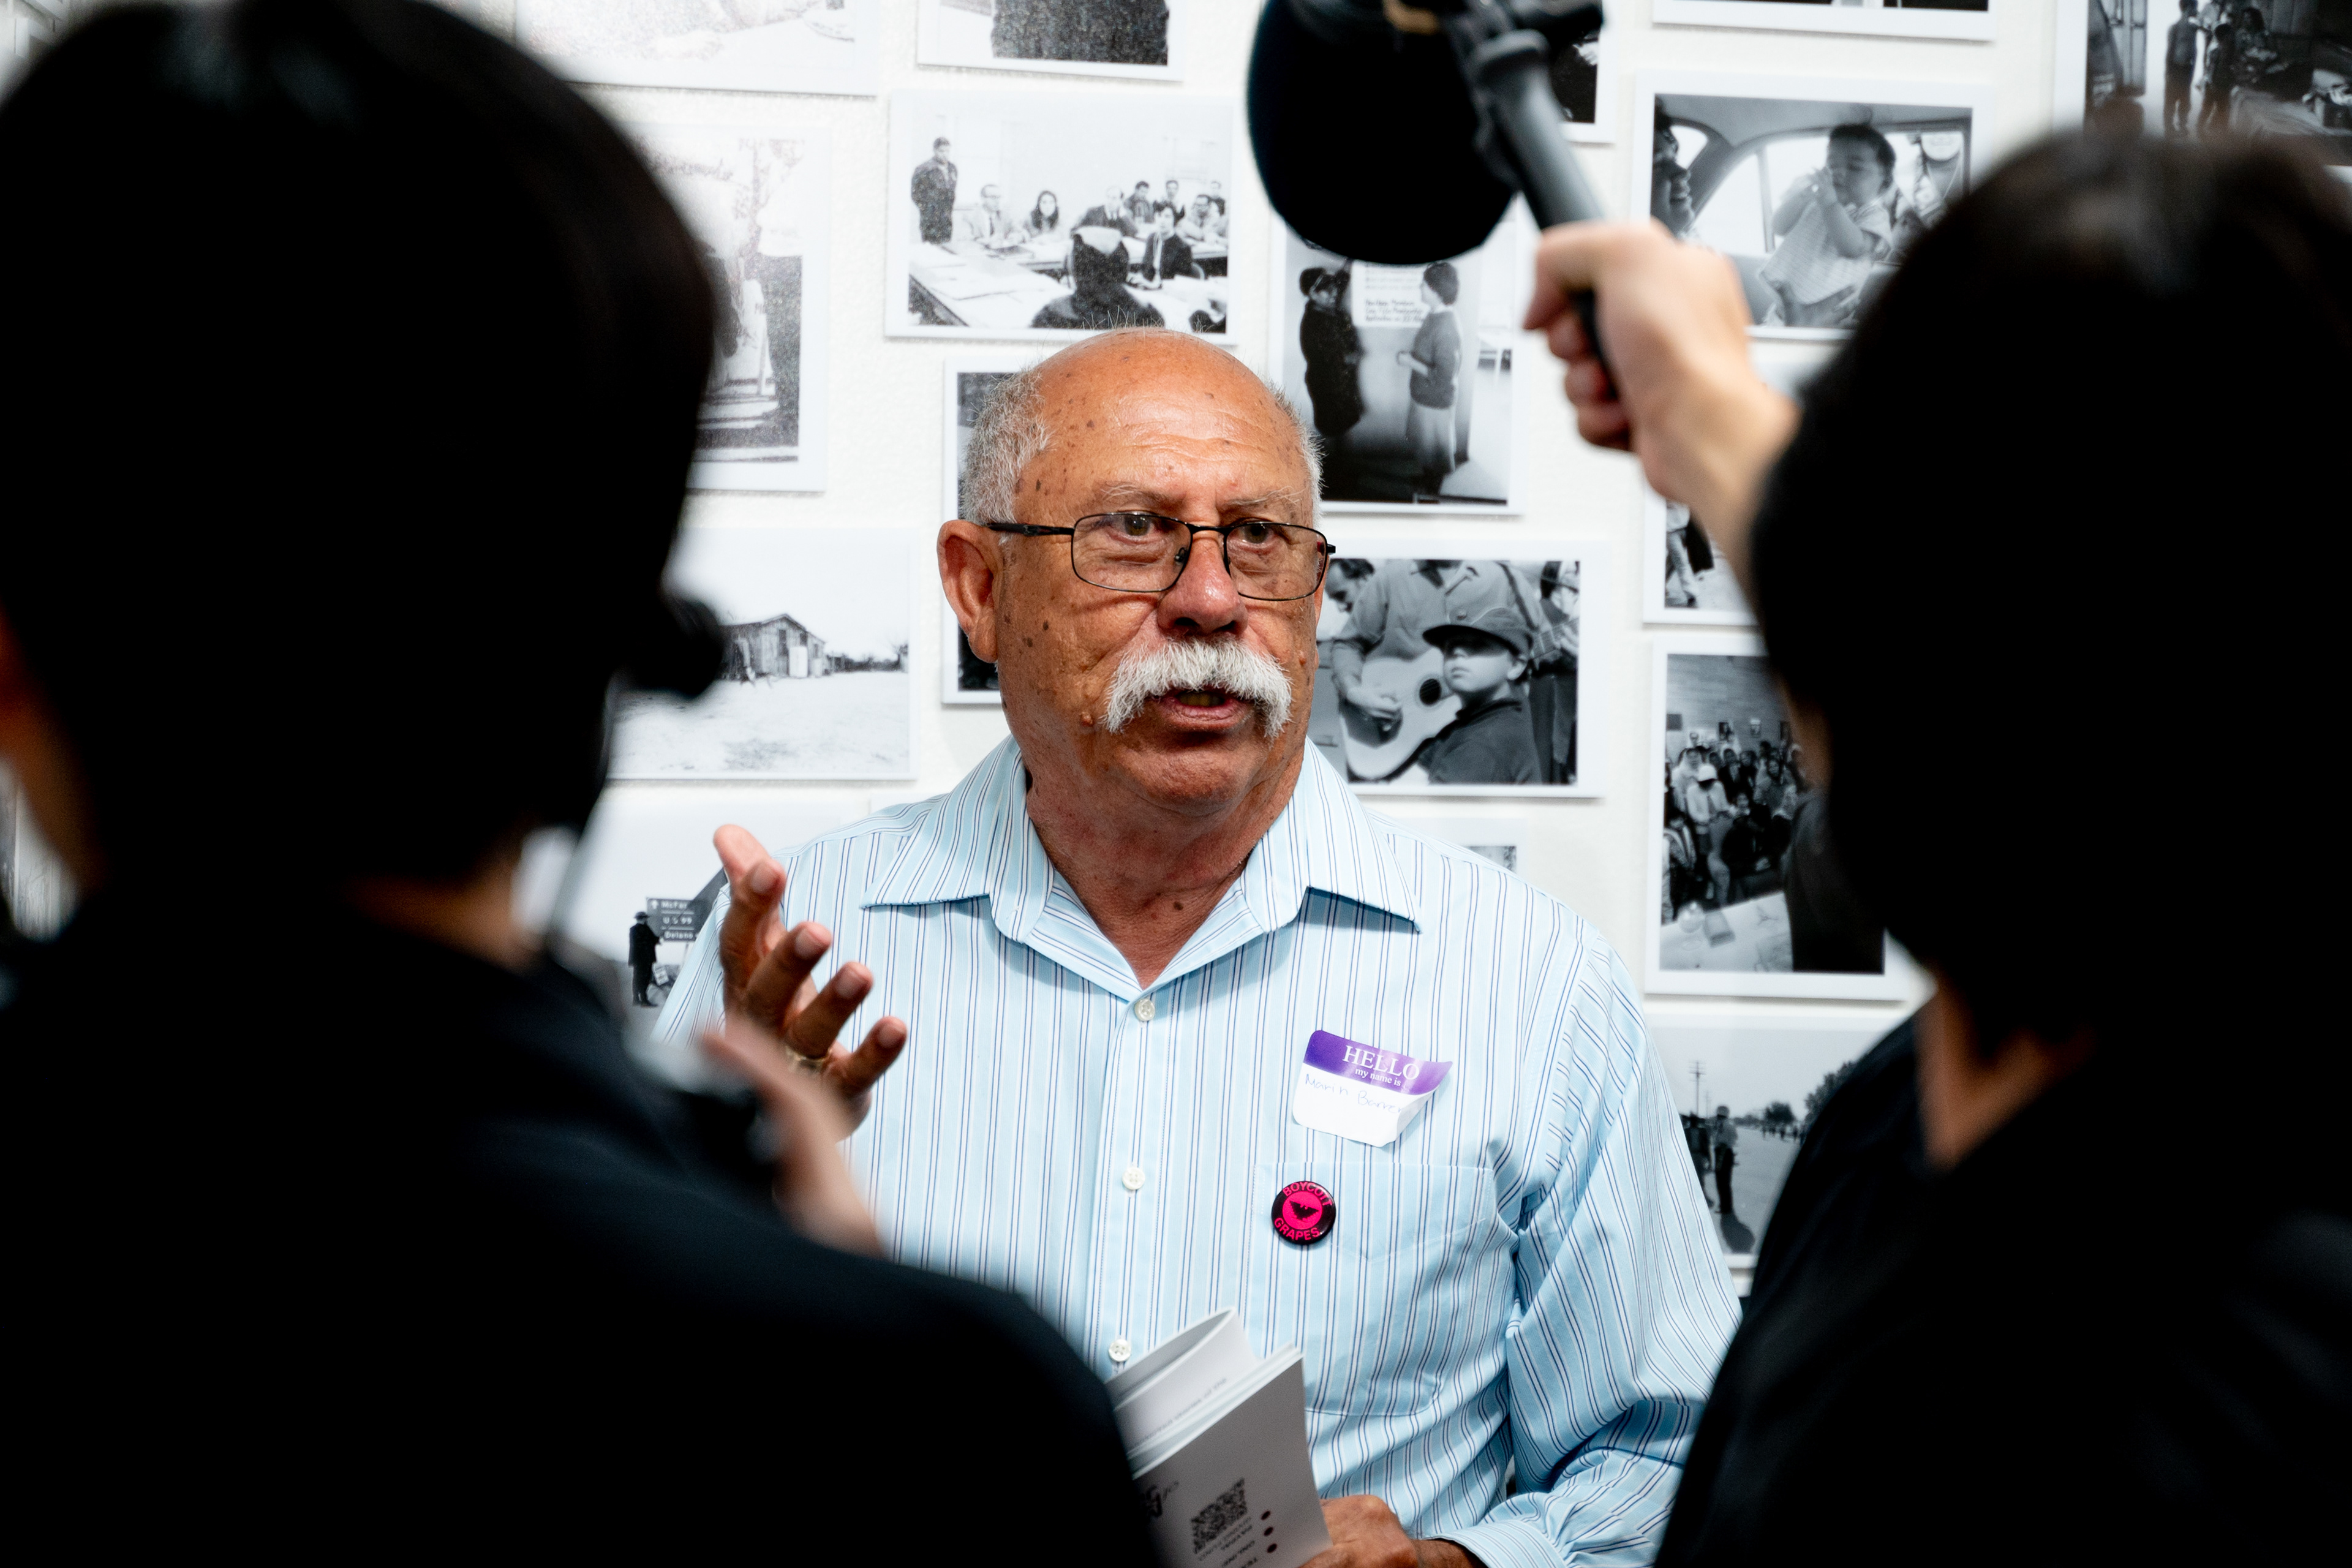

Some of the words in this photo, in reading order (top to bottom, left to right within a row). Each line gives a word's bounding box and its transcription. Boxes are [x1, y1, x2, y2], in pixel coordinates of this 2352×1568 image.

[664, 931, 693, 940] Delano
[1342, 1045, 1420, 1080] HELLO
[1355, 1068, 1369, 1079] my
[1370, 1072, 1392, 1084] name
[1393, 1078, 1401, 1087] is
[1282, 1181, 1333, 1206] BOYCOTT
[1274, 1217, 1321, 1241] GRAPES
